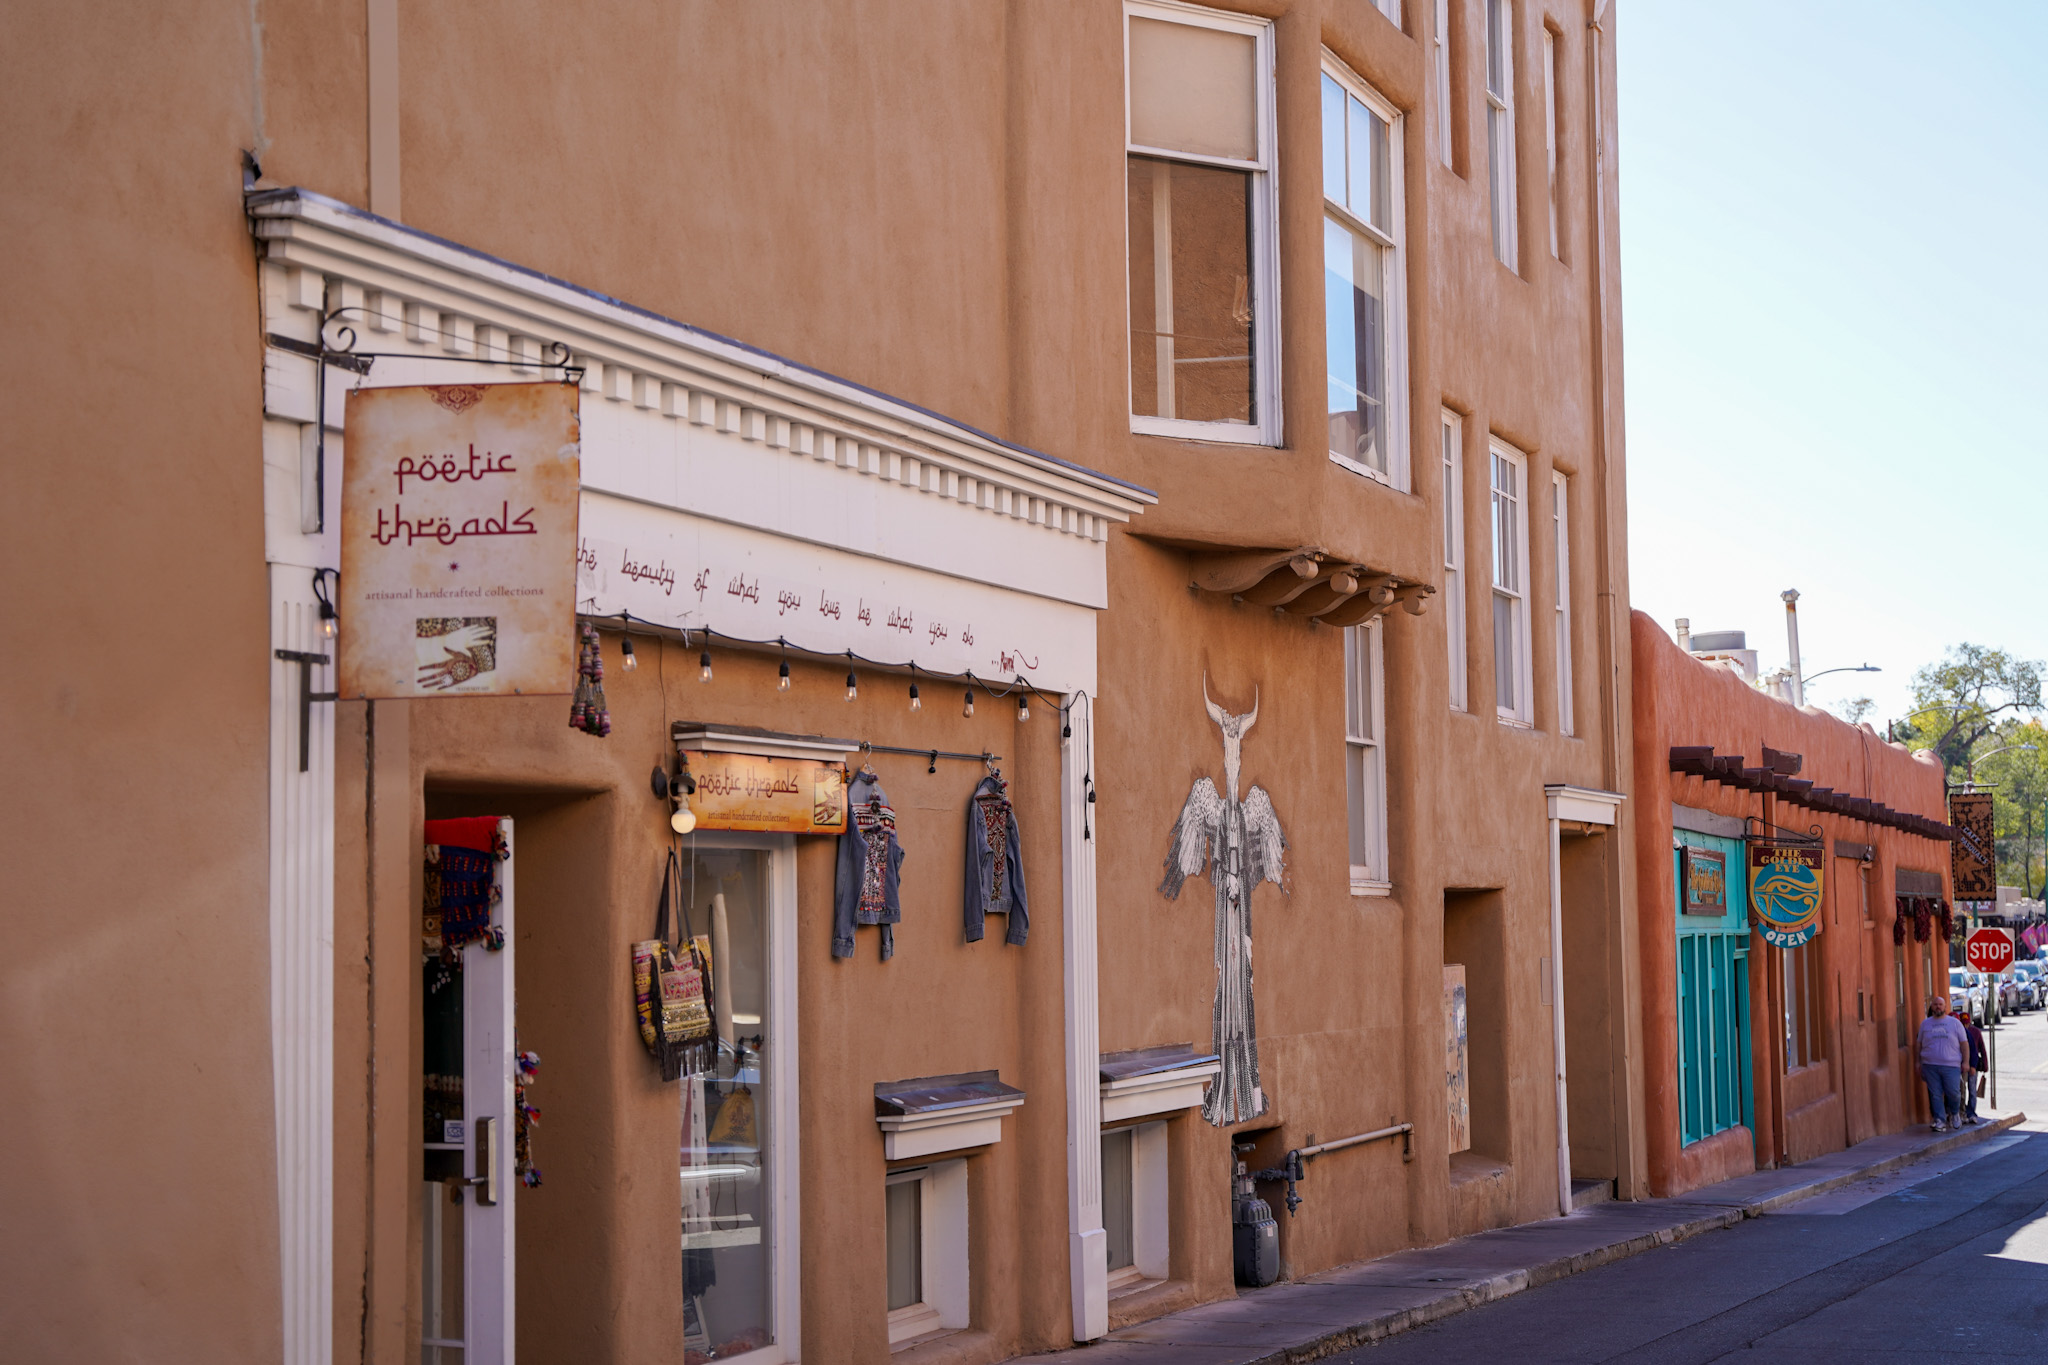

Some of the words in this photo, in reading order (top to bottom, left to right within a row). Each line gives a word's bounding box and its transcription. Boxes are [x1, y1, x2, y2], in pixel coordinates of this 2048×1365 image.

[365, 589, 412, 600] artisanal
[416, 587, 481, 599] handcrafted
[484, 585, 544, 597] collections
[1963, 827, 1981, 843] CAFE
[1772, 848, 1802, 857] THE
[1760, 855, 1815, 866] GOLDEN
[1775, 864, 1800, 873] EYE
[1765, 930, 1808, 947] OPEN
[1969, 942, 2011, 960] STOP
